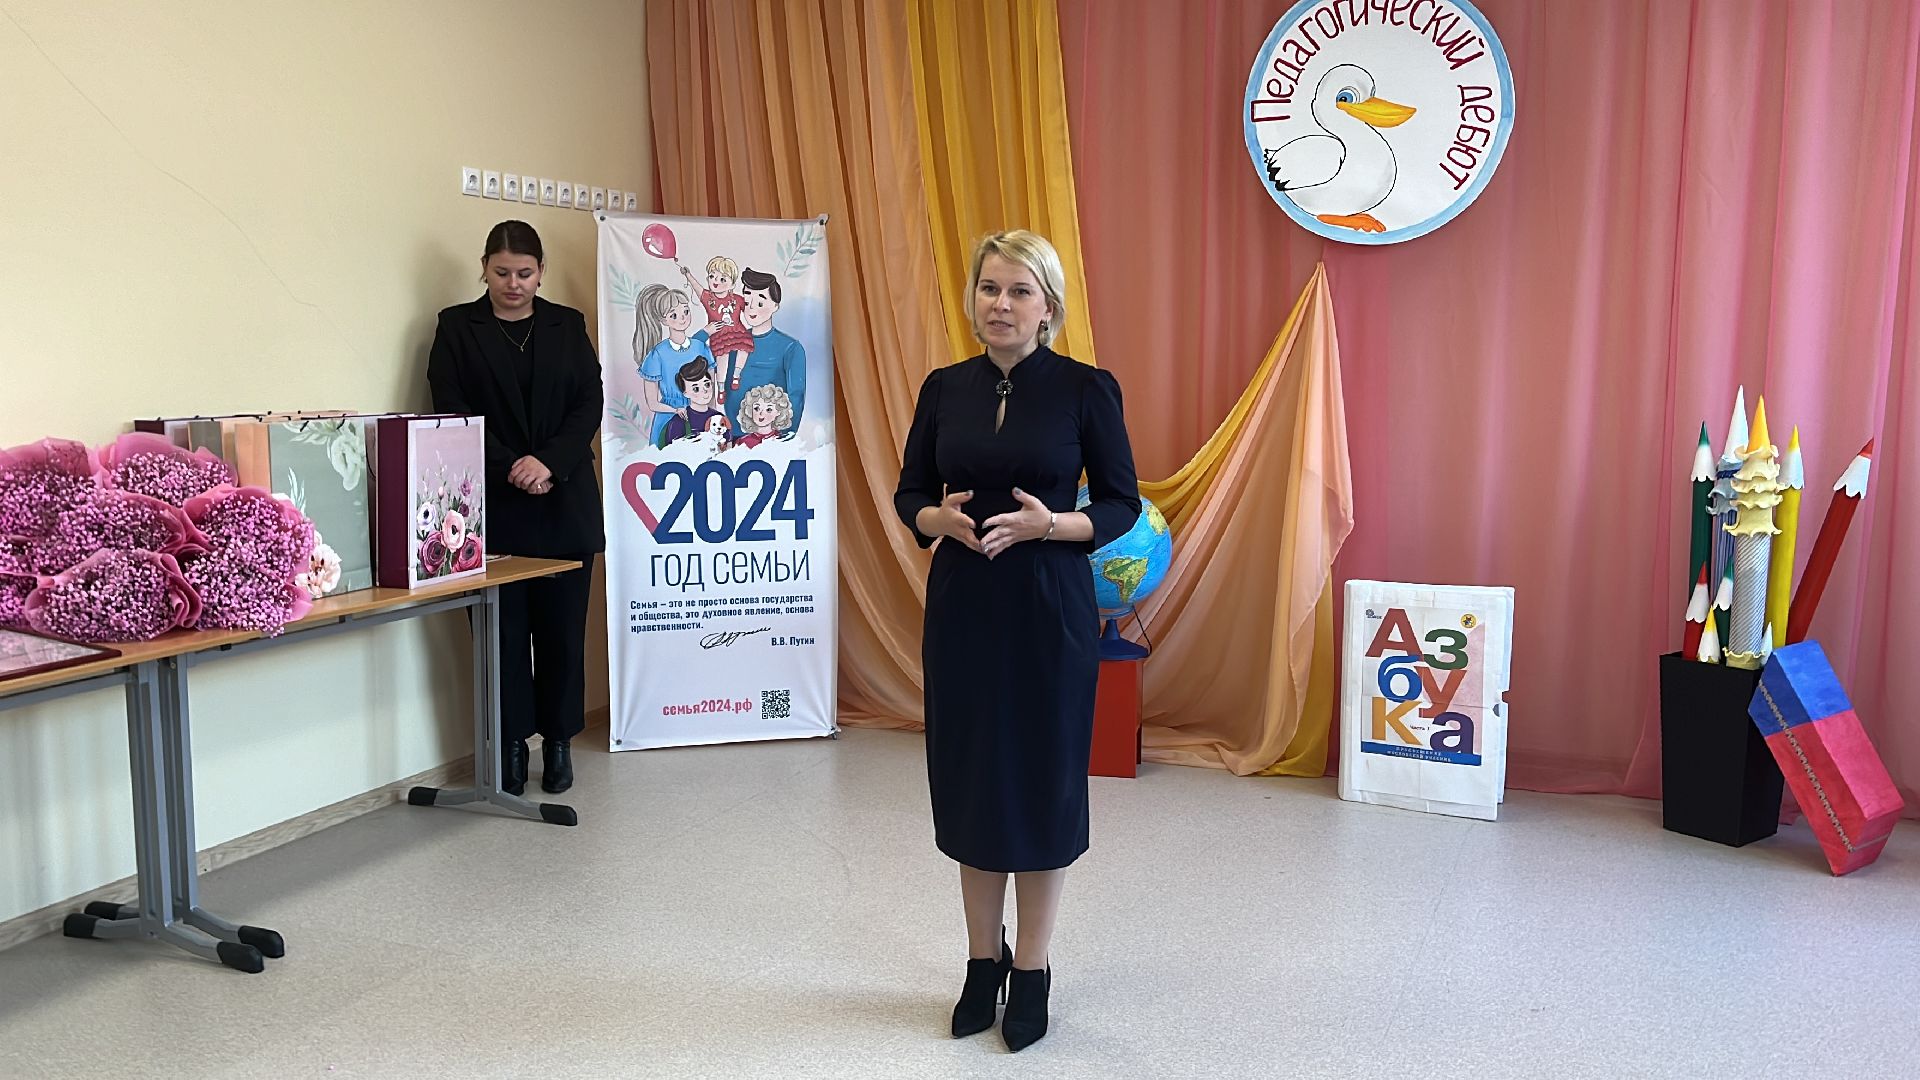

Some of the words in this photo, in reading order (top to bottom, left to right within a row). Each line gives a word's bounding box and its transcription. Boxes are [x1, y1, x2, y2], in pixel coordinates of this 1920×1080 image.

[651, 459, 815, 544] 2024
[630, 600, 658, 610] Семья
[668, 600, 683, 608] это
[698, 598, 728, 608] просто
[729, 597, 760, 605] основа
[761, 594, 813, 604] государства
[638, 612, 683, 621] общества,
[685, 611, 699, 619] это
[701, 609, 742, 619] духовное
[744, 607, 783, 616] явление,
[785, 606, 814, 614] основа
[631, 622, 704, 634] нравственности.
[771, 637, 788, 646] В.В.
[789, 636, 815, 646] Путин
[662, 698, 753, 716] семья2024.рф
